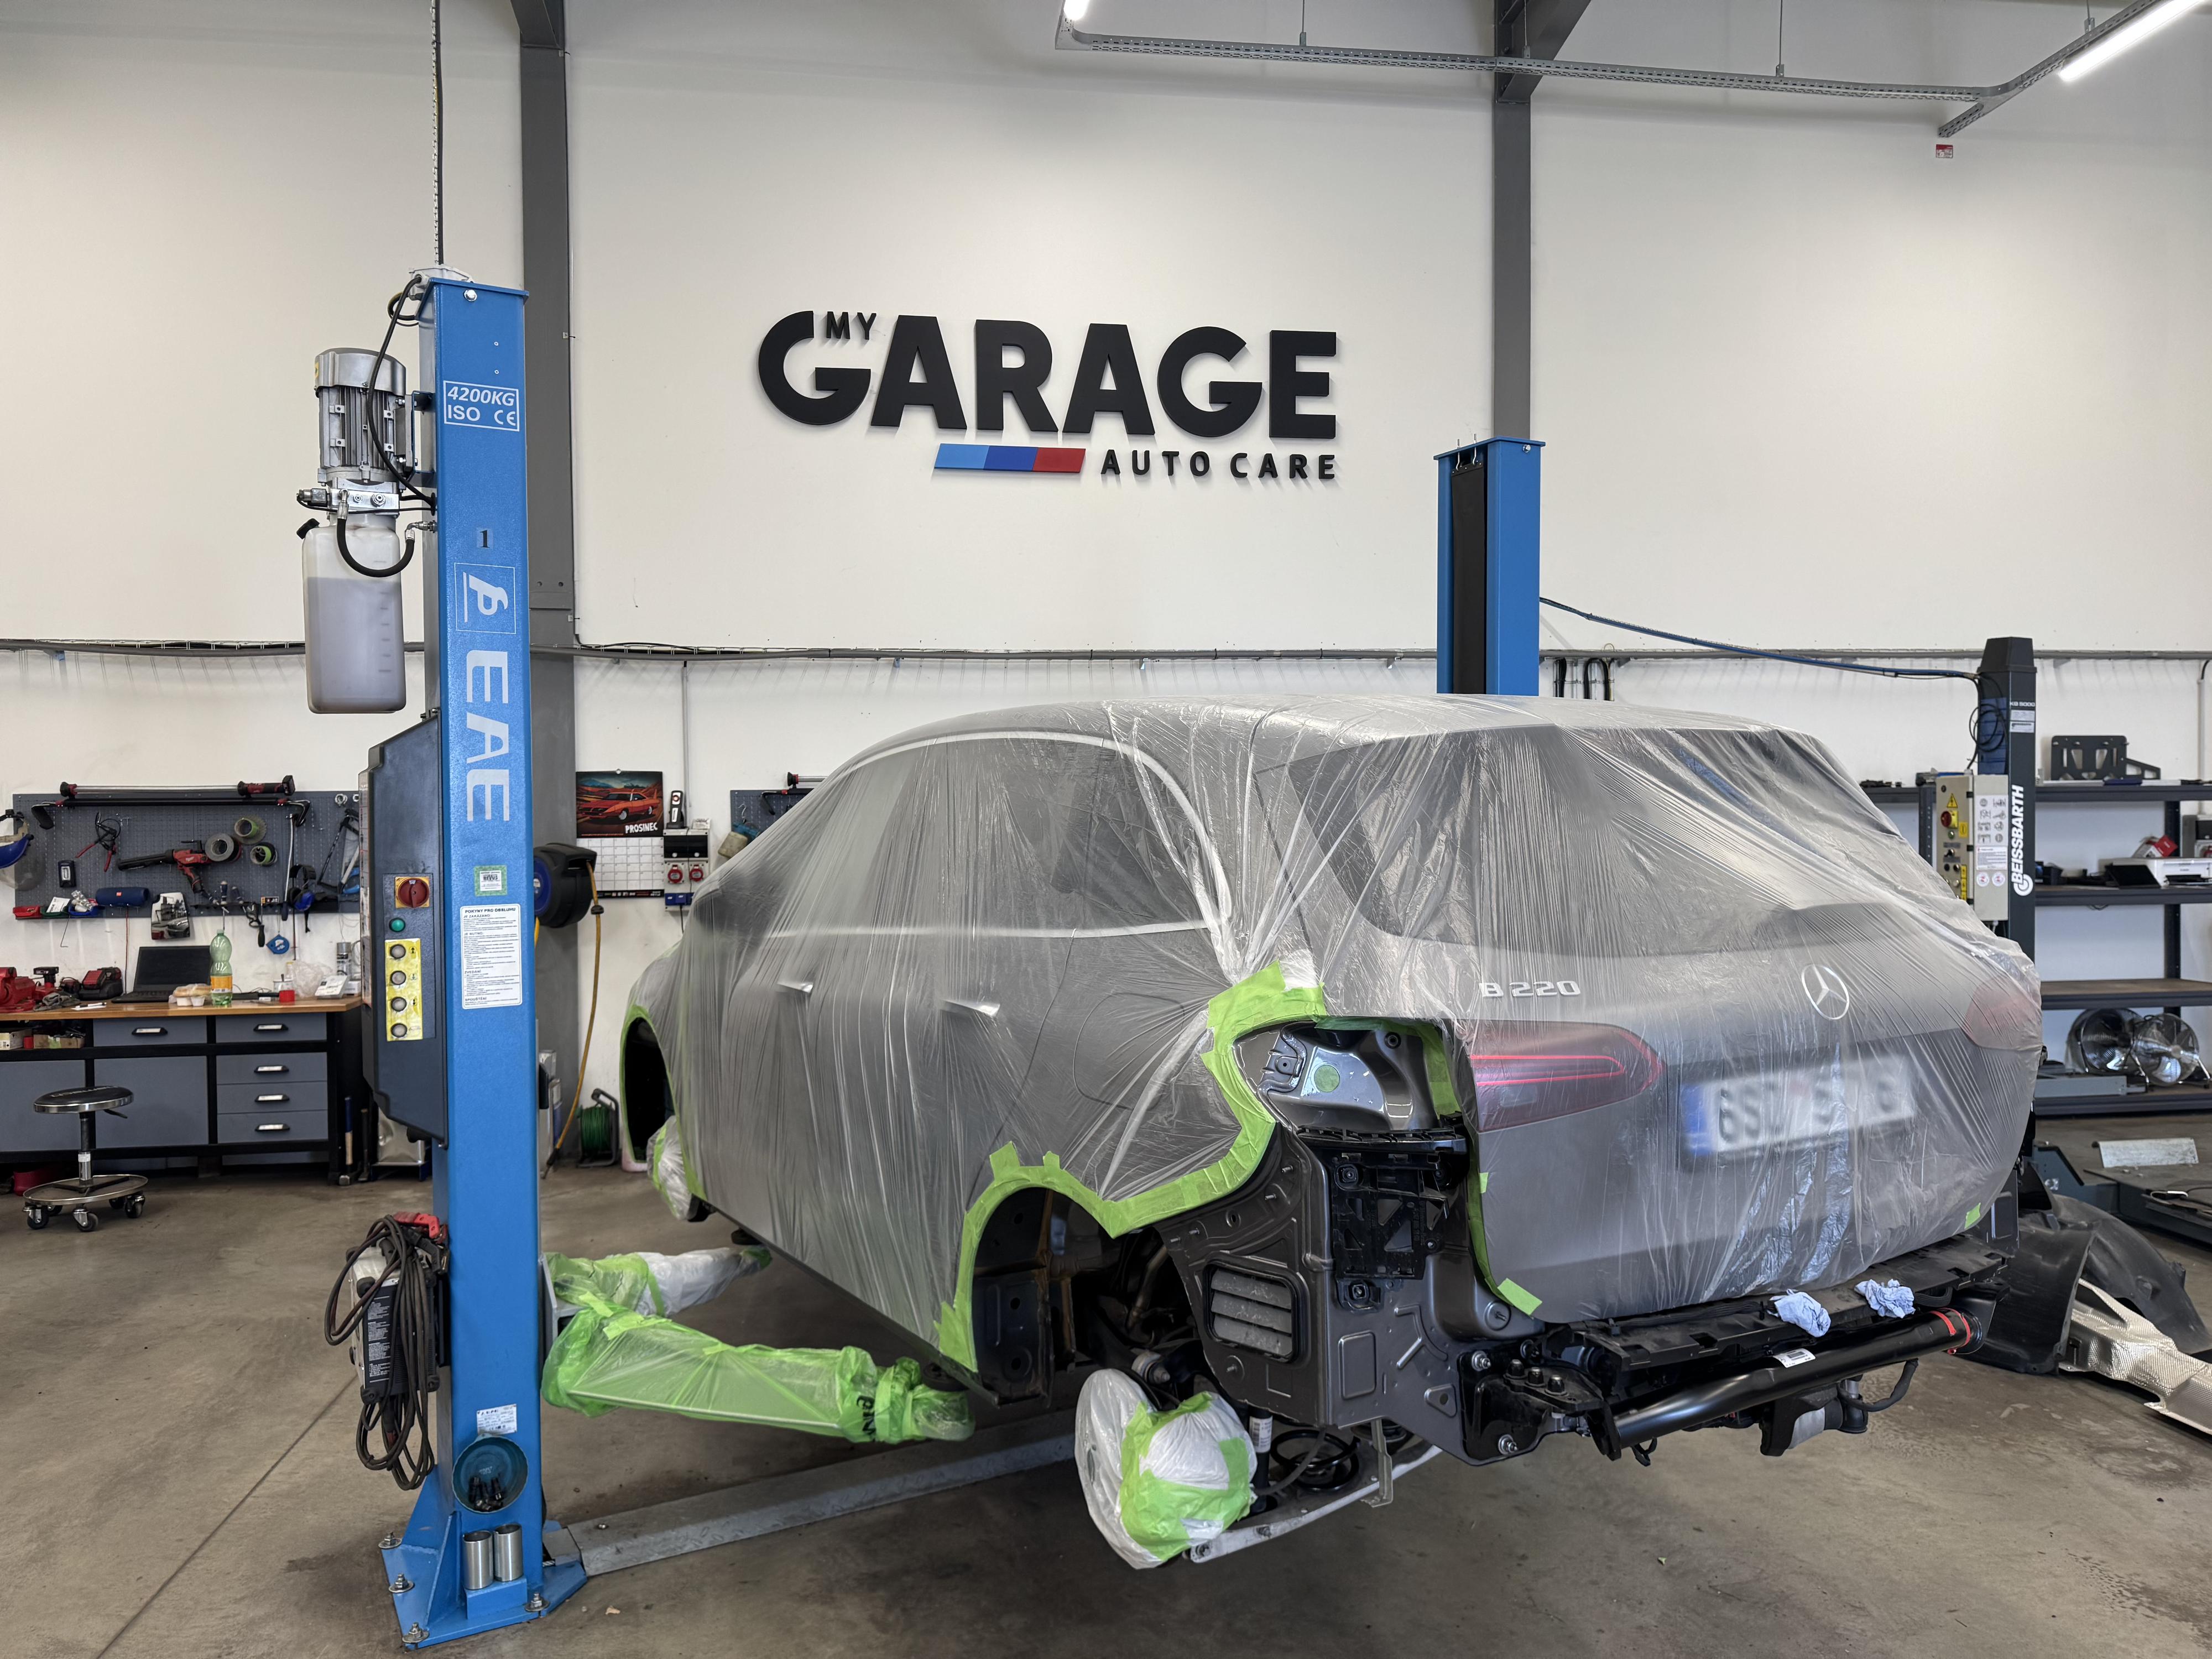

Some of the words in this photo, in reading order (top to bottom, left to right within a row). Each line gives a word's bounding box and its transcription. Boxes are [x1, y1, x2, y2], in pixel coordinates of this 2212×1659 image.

[825, 311, 877, 341] MY
[758, 310, 1337, 439] GARAGE
[447, 386, 515, 406] 4200KG
[447, 404, 481, 422] ISO
[1100, 448, 1211, 477] AUTO
[1230, 452, 1336, 479] CARE
[479, 529, 491, 549] 1
[466, 649, 510, 822] EAE
[625, 822, 658, 834] PROSINEC
[2011, 784, 2024, 886] BEISSBARTH
[1479, 982, 1504, 997] B
[1509, 980, 1581, 997] 220
